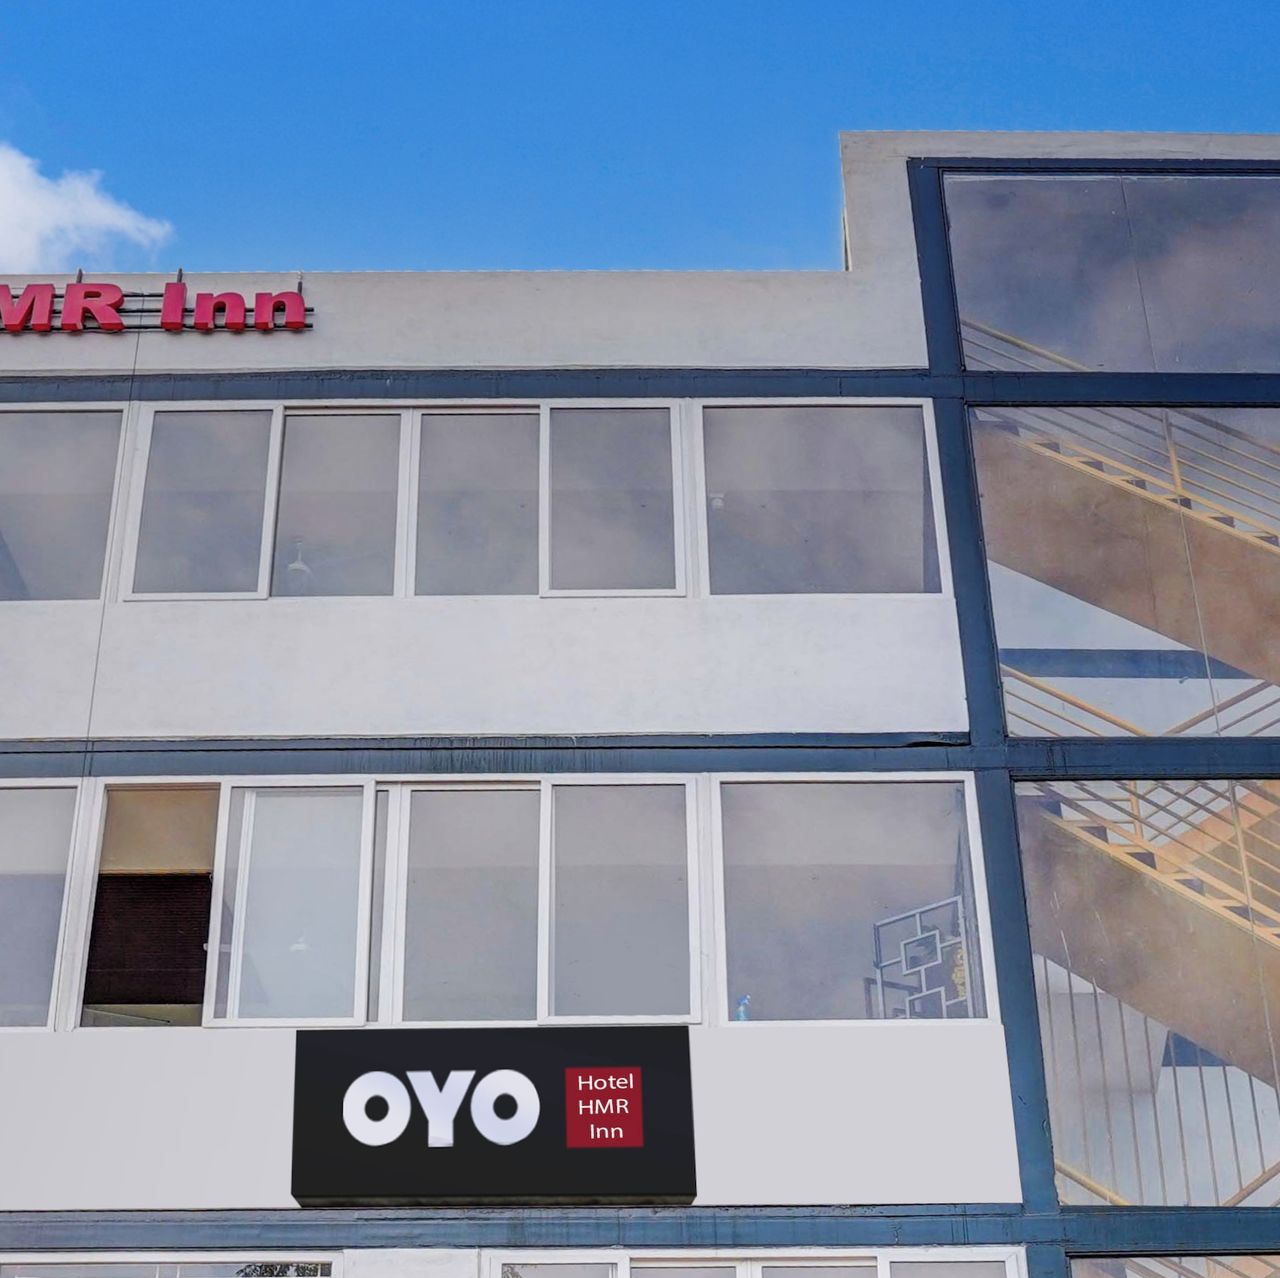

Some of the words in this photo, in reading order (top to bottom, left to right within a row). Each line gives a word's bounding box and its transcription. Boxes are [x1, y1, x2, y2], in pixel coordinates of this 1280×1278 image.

[160, 282, 306, 333] Inn
[578, 1073, 634, 1091] Hotel
[342, 1069, 541, 1148] OYO
[578, 1098, 629, 1115] HMR
[590, 1123, 624, 1140] Inn
